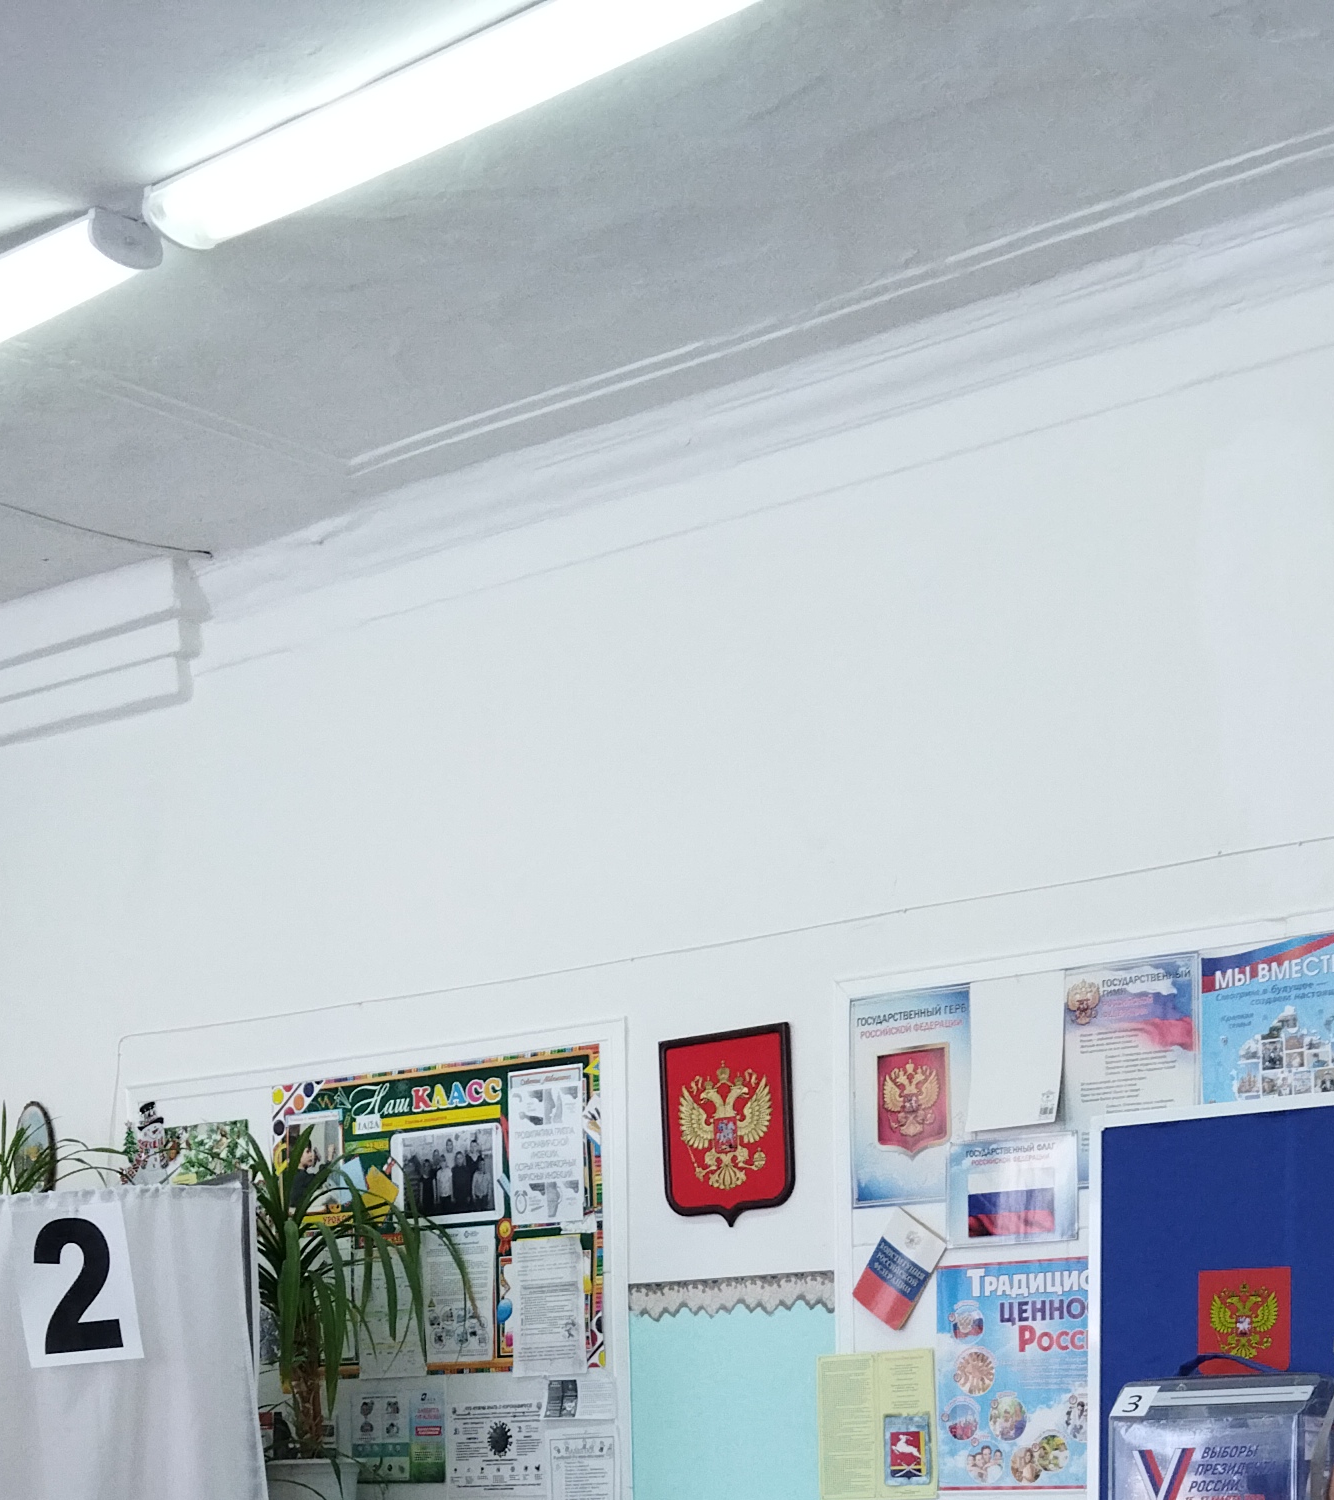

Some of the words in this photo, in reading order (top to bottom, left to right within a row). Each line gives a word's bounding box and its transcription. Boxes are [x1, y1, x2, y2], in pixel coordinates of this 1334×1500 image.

[1102, 968, 1191, 988] ГОСУДАРСТВЕННЫЙ
[1215, 965, 1251, 990] МЫ
[857, 1004, 942, 1027] ГОСУДАРСТВЕННЫЙ
[944, 1003, 967, 1015] ГЕРБ
[350, 1082, 411, 1118] Наш
[412, 1077, 502, 1112] КЛАСС
[966, 1144, 1035, 1158] ГОСУДАРСТВЕННЫЙ
[33, 1217, 125, 1354] 2
[999, 1297, 1088, 1327] ЦЕННО
[1122, 1394, 1142, 1413] 3
[1201, 1445, 1259, 1460] ВЫБОРЫ
[1188, 1480, 1240, 1493] РОССИИ
